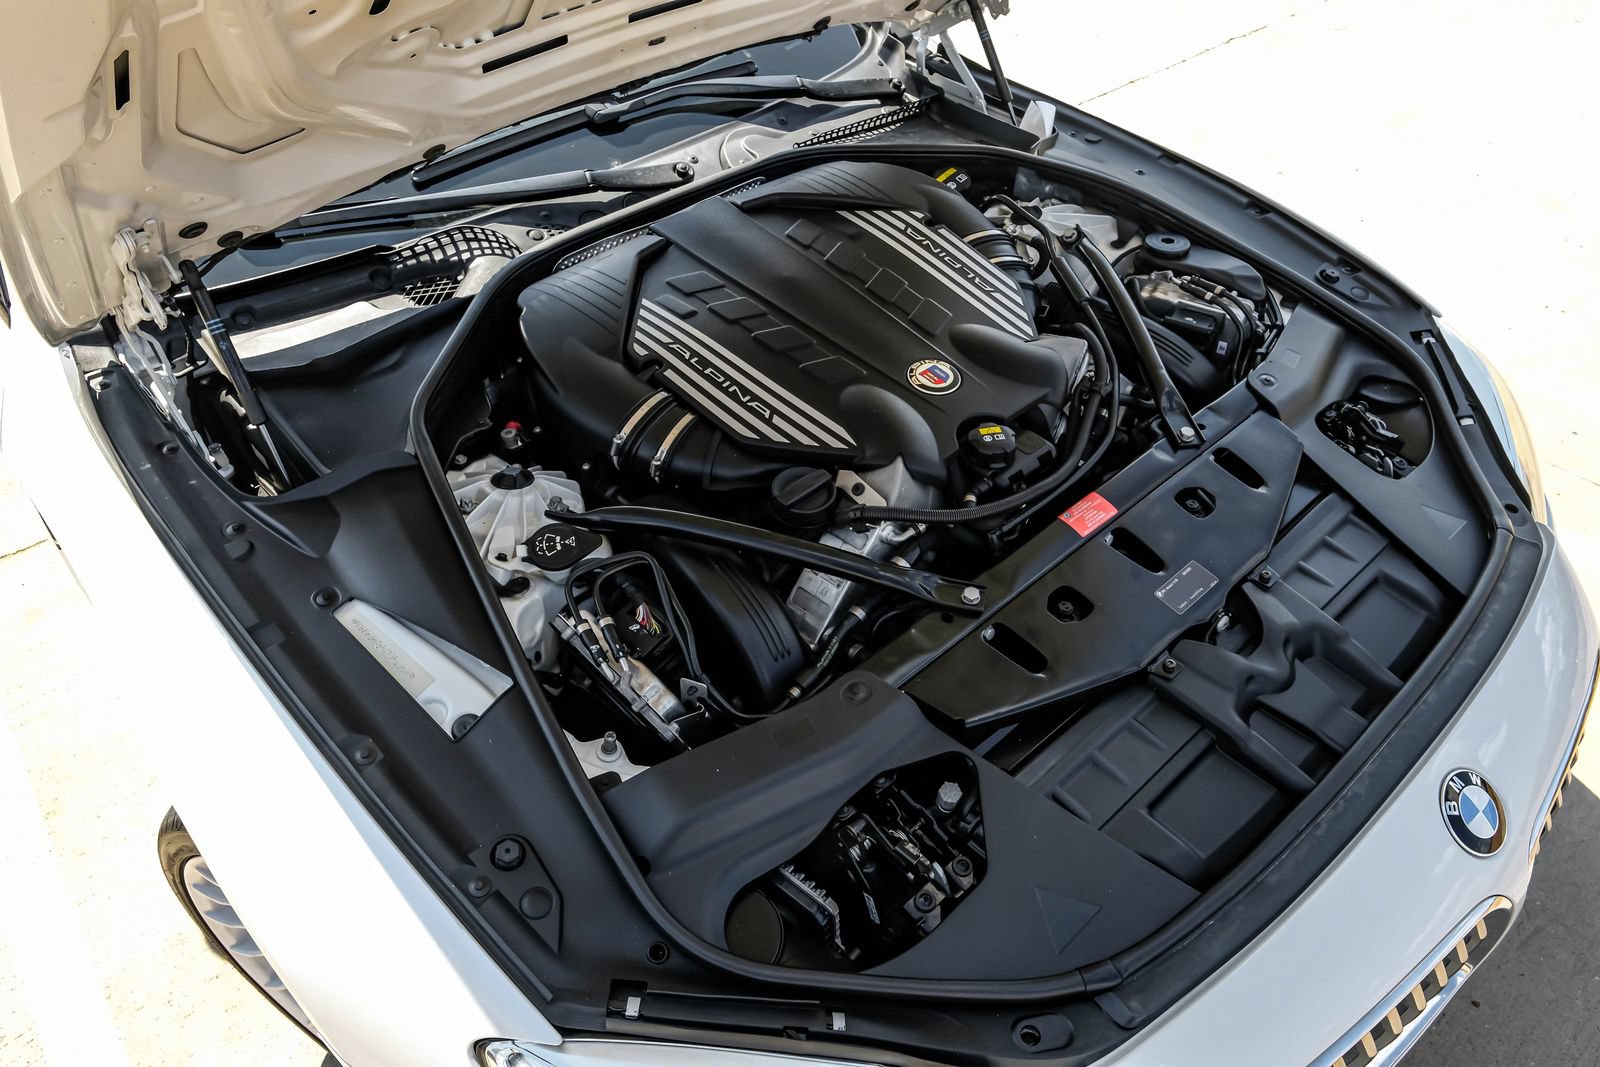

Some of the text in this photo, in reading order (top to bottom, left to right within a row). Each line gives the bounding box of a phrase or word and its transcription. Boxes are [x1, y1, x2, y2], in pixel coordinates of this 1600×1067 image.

[905, 226, 995, 293] ALPINA
[667, 343, 770, 419] ALPINA
[909, 359, 951, 385] ALPINA
[1445, 772, 1482, 816] BMW
